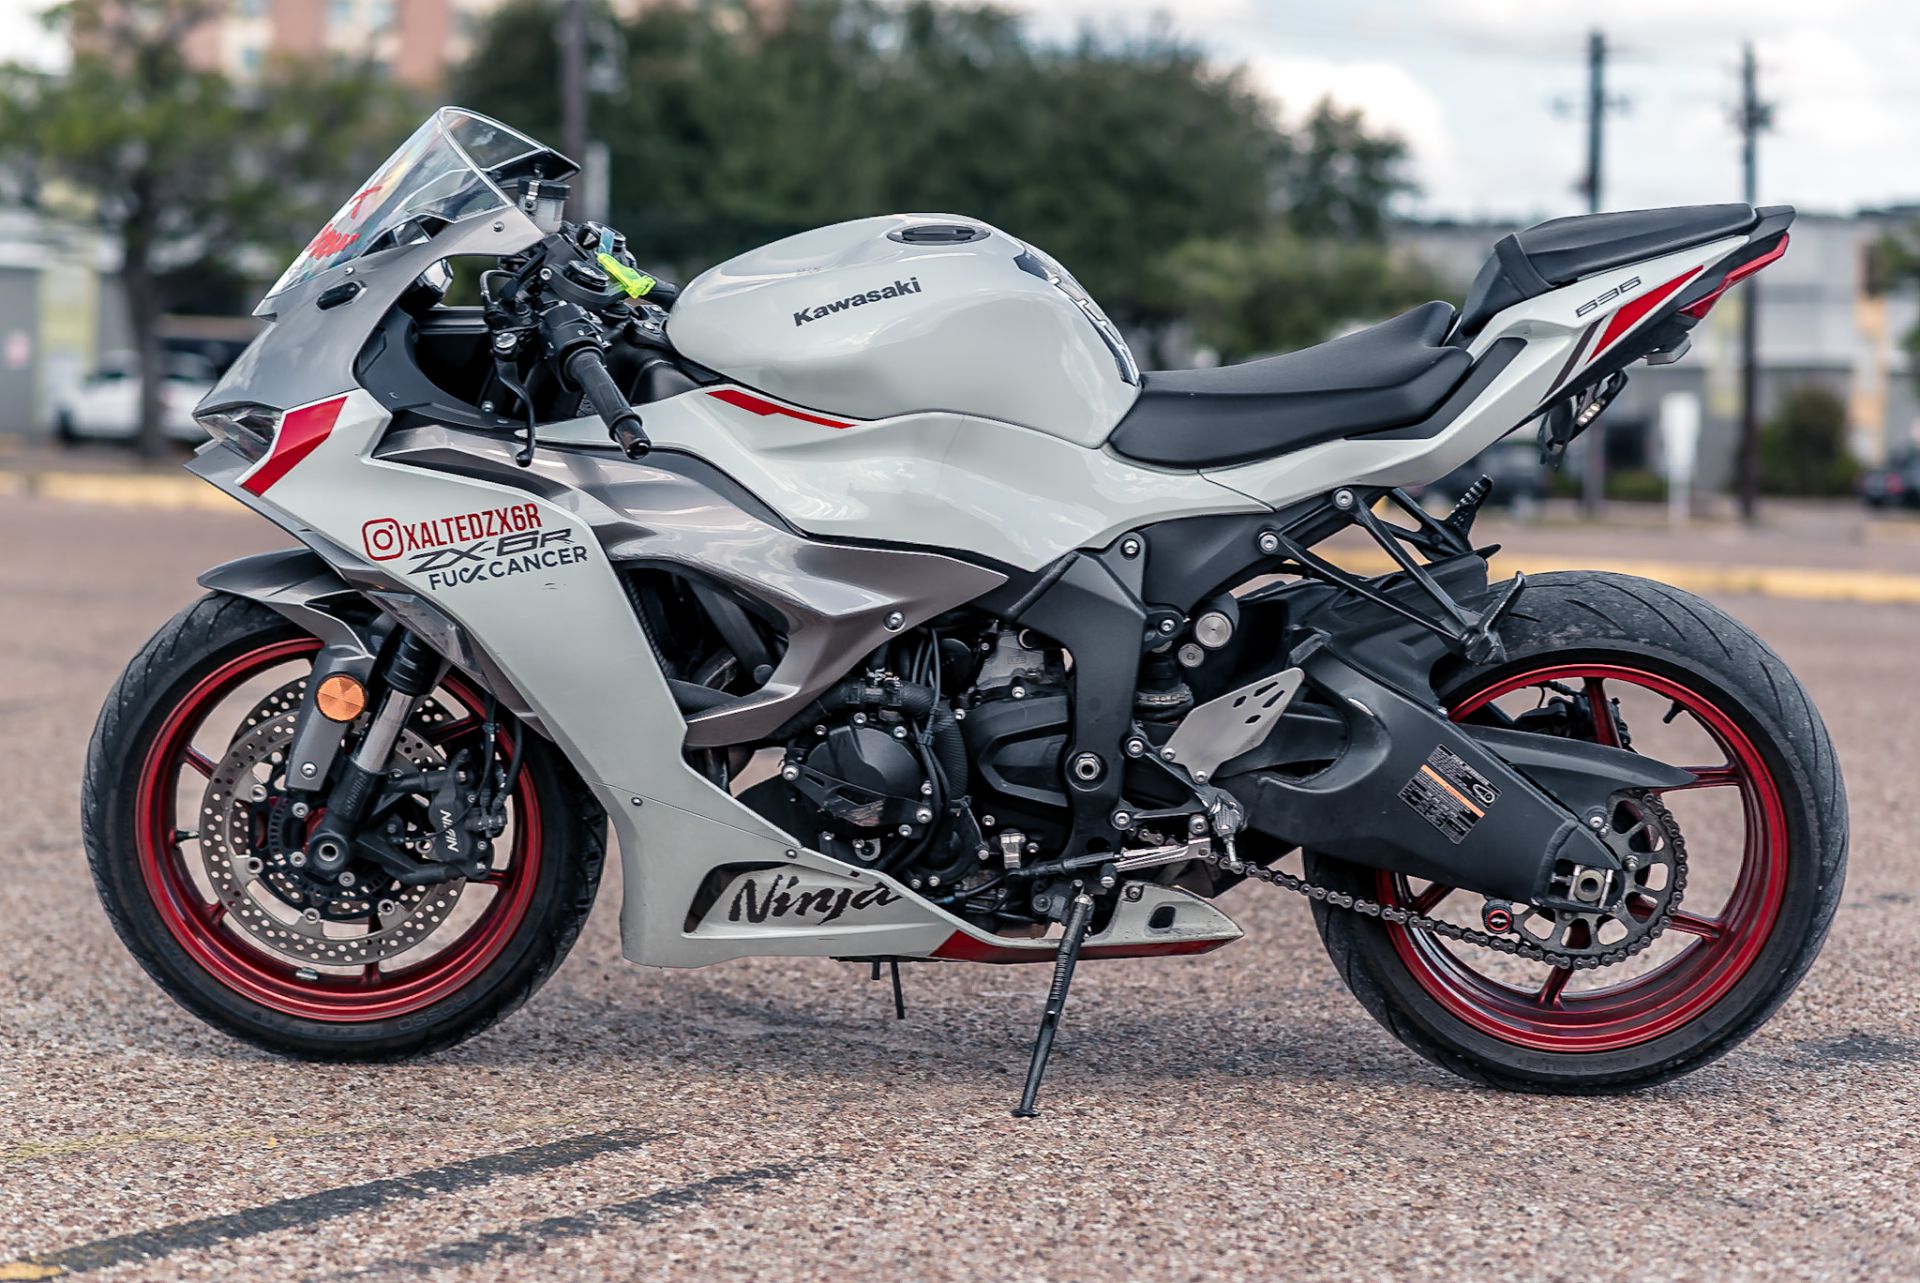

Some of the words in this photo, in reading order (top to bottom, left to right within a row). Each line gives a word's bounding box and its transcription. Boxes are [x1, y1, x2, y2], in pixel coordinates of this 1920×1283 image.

[792, 276, 922, 327] Kawasaki
[1575, 275, 1642, 318] 636
[403, 503, 542, 551] XALTEDZX6R
[407, 528, 574, 575] ZX-6R
[489, 545, 588, 578] CANCER
[439, 809, 460, 853] NISIN
[728, 873, 904, 926] Ninja
